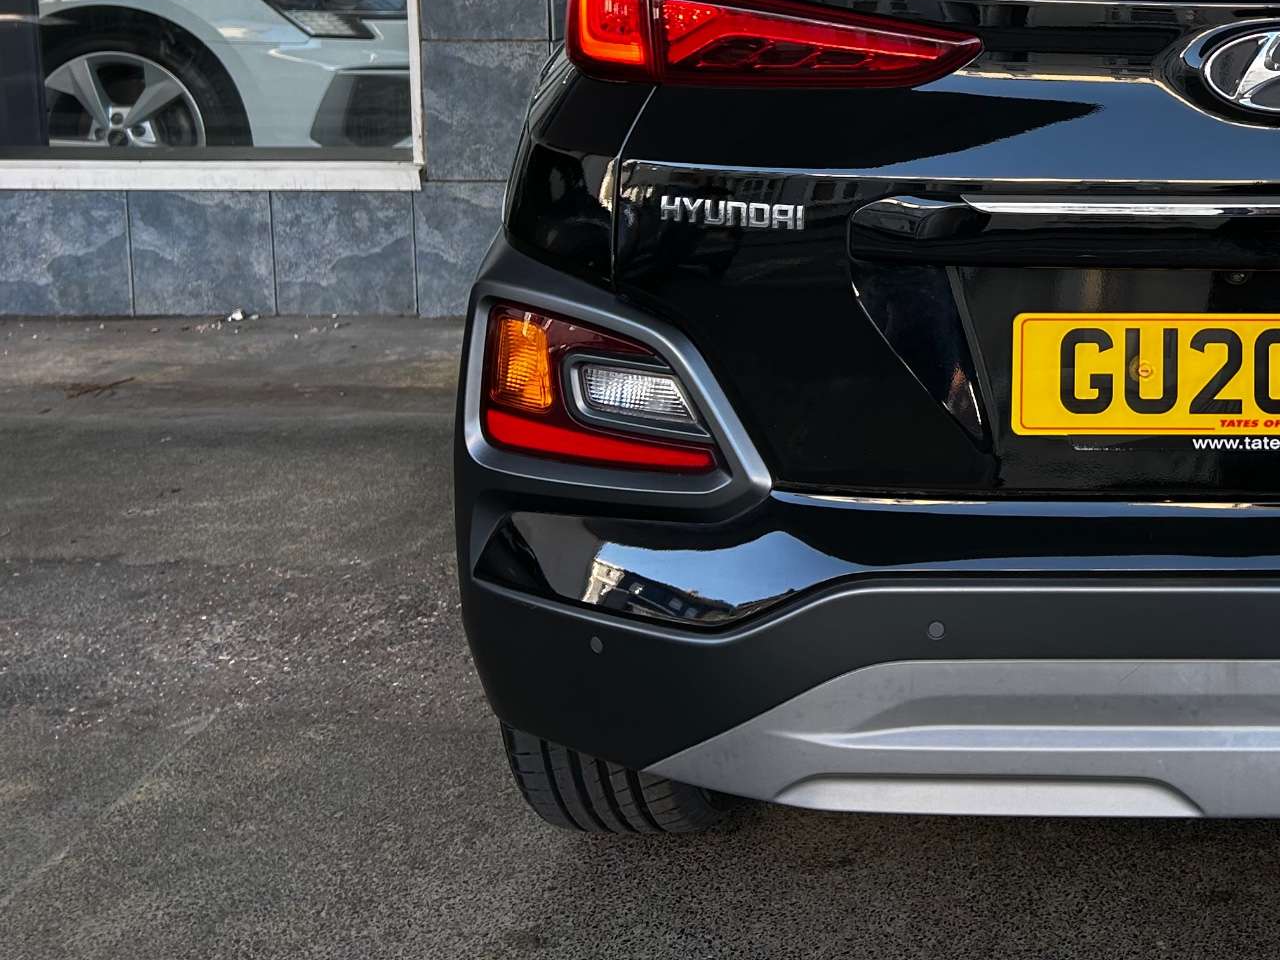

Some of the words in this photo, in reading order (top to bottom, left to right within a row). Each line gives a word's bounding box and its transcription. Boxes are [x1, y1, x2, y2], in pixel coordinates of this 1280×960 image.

[660, 195, 805, 230] HYUNDAI
[1220, 419, 1259, 428] TATES
[1263, 419, 1280, 428] OF
